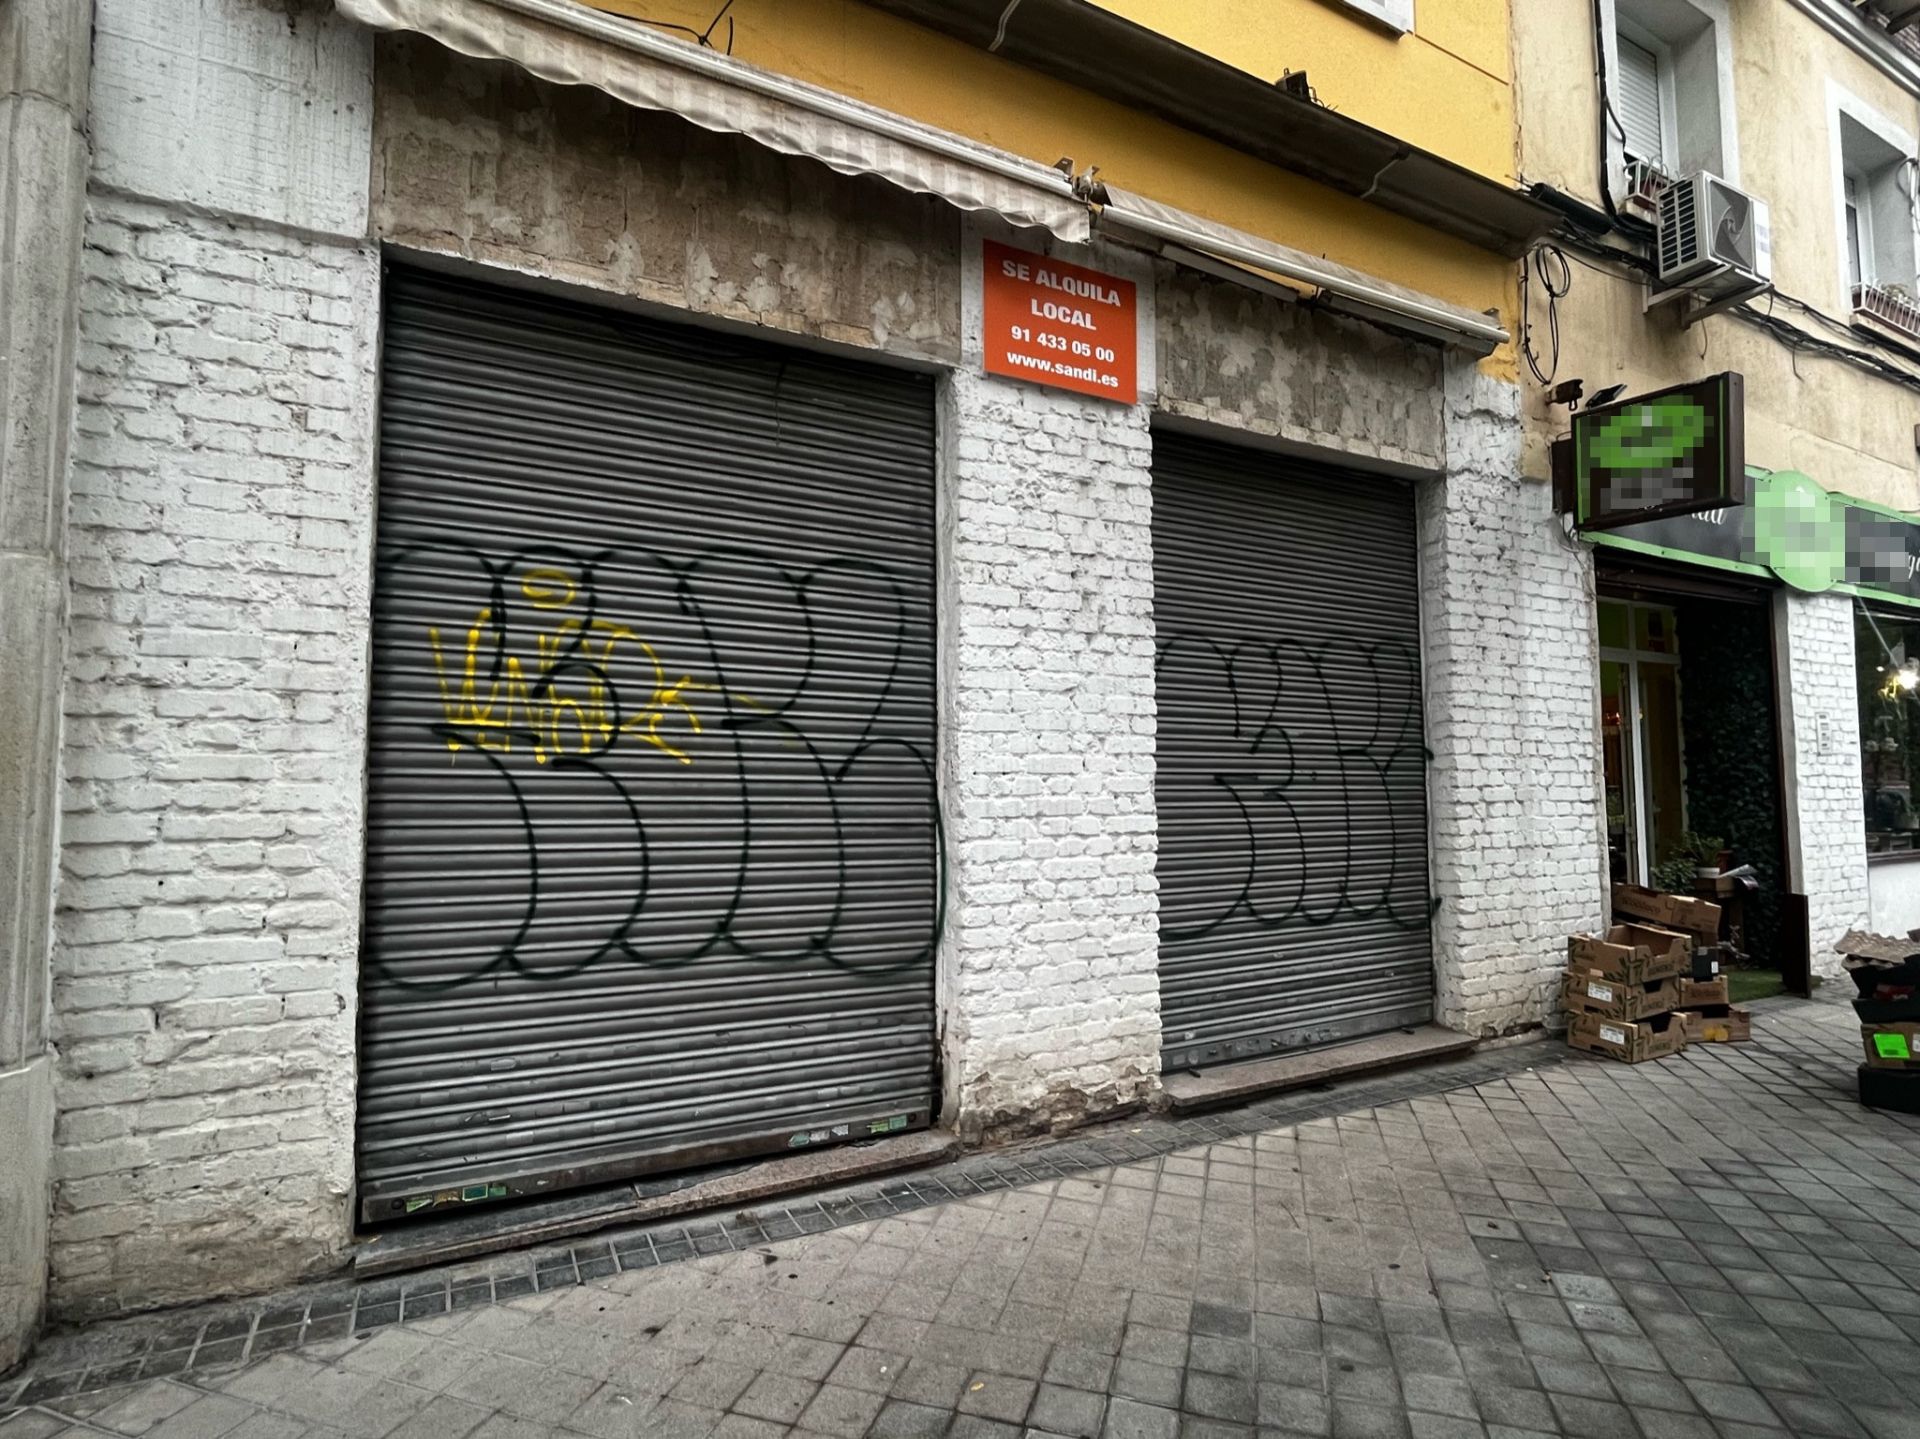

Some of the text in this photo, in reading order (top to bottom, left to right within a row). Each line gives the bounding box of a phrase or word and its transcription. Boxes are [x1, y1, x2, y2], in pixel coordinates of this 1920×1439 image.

[1002, 259, 1121, 307] SE ALQUILA
[1031, 298, 1097, 331] LOCAL
[1011, 325, 1115, 363] 91 433 05 00
[1006, 351, 1119, 388] www.sandi.es
